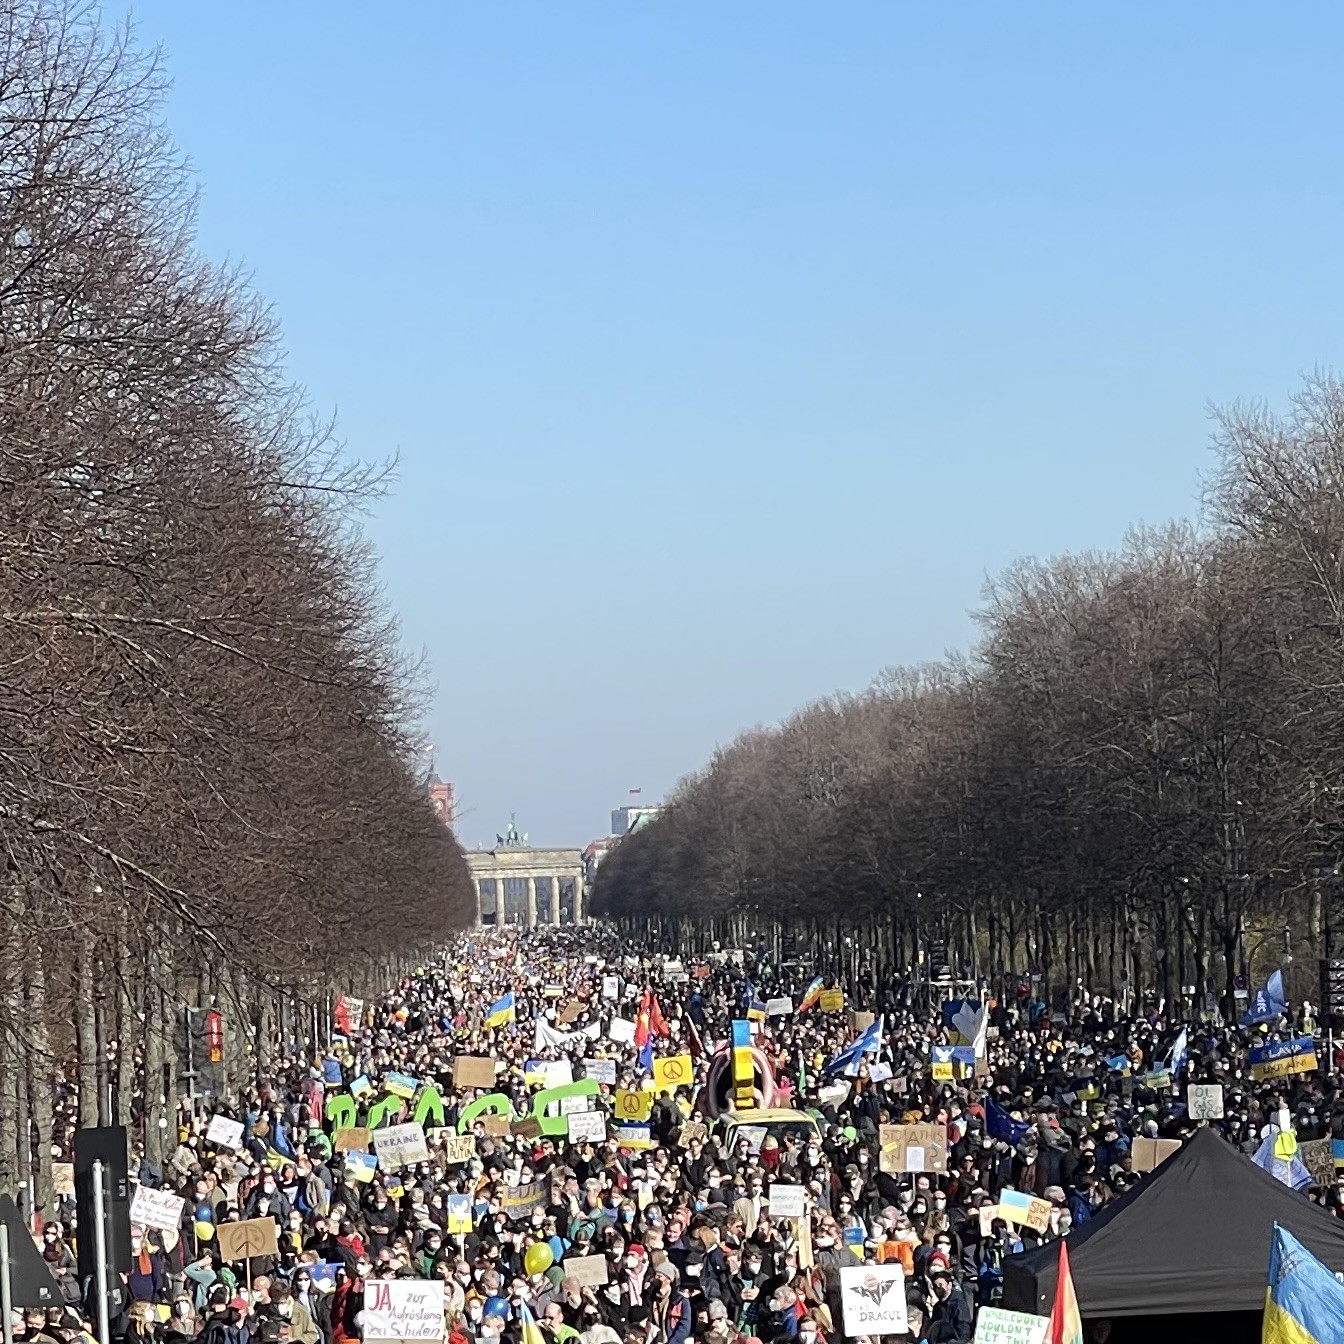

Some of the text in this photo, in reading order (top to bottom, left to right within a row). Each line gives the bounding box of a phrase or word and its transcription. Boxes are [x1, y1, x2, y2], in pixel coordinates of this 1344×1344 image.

[377, 1133, 420, 1149] UKRAINE
[367, 1283, 392, 1311] JA
[390, 1321, 441, 1338] Schulen
[976, 1332, 999, 1343] LET
